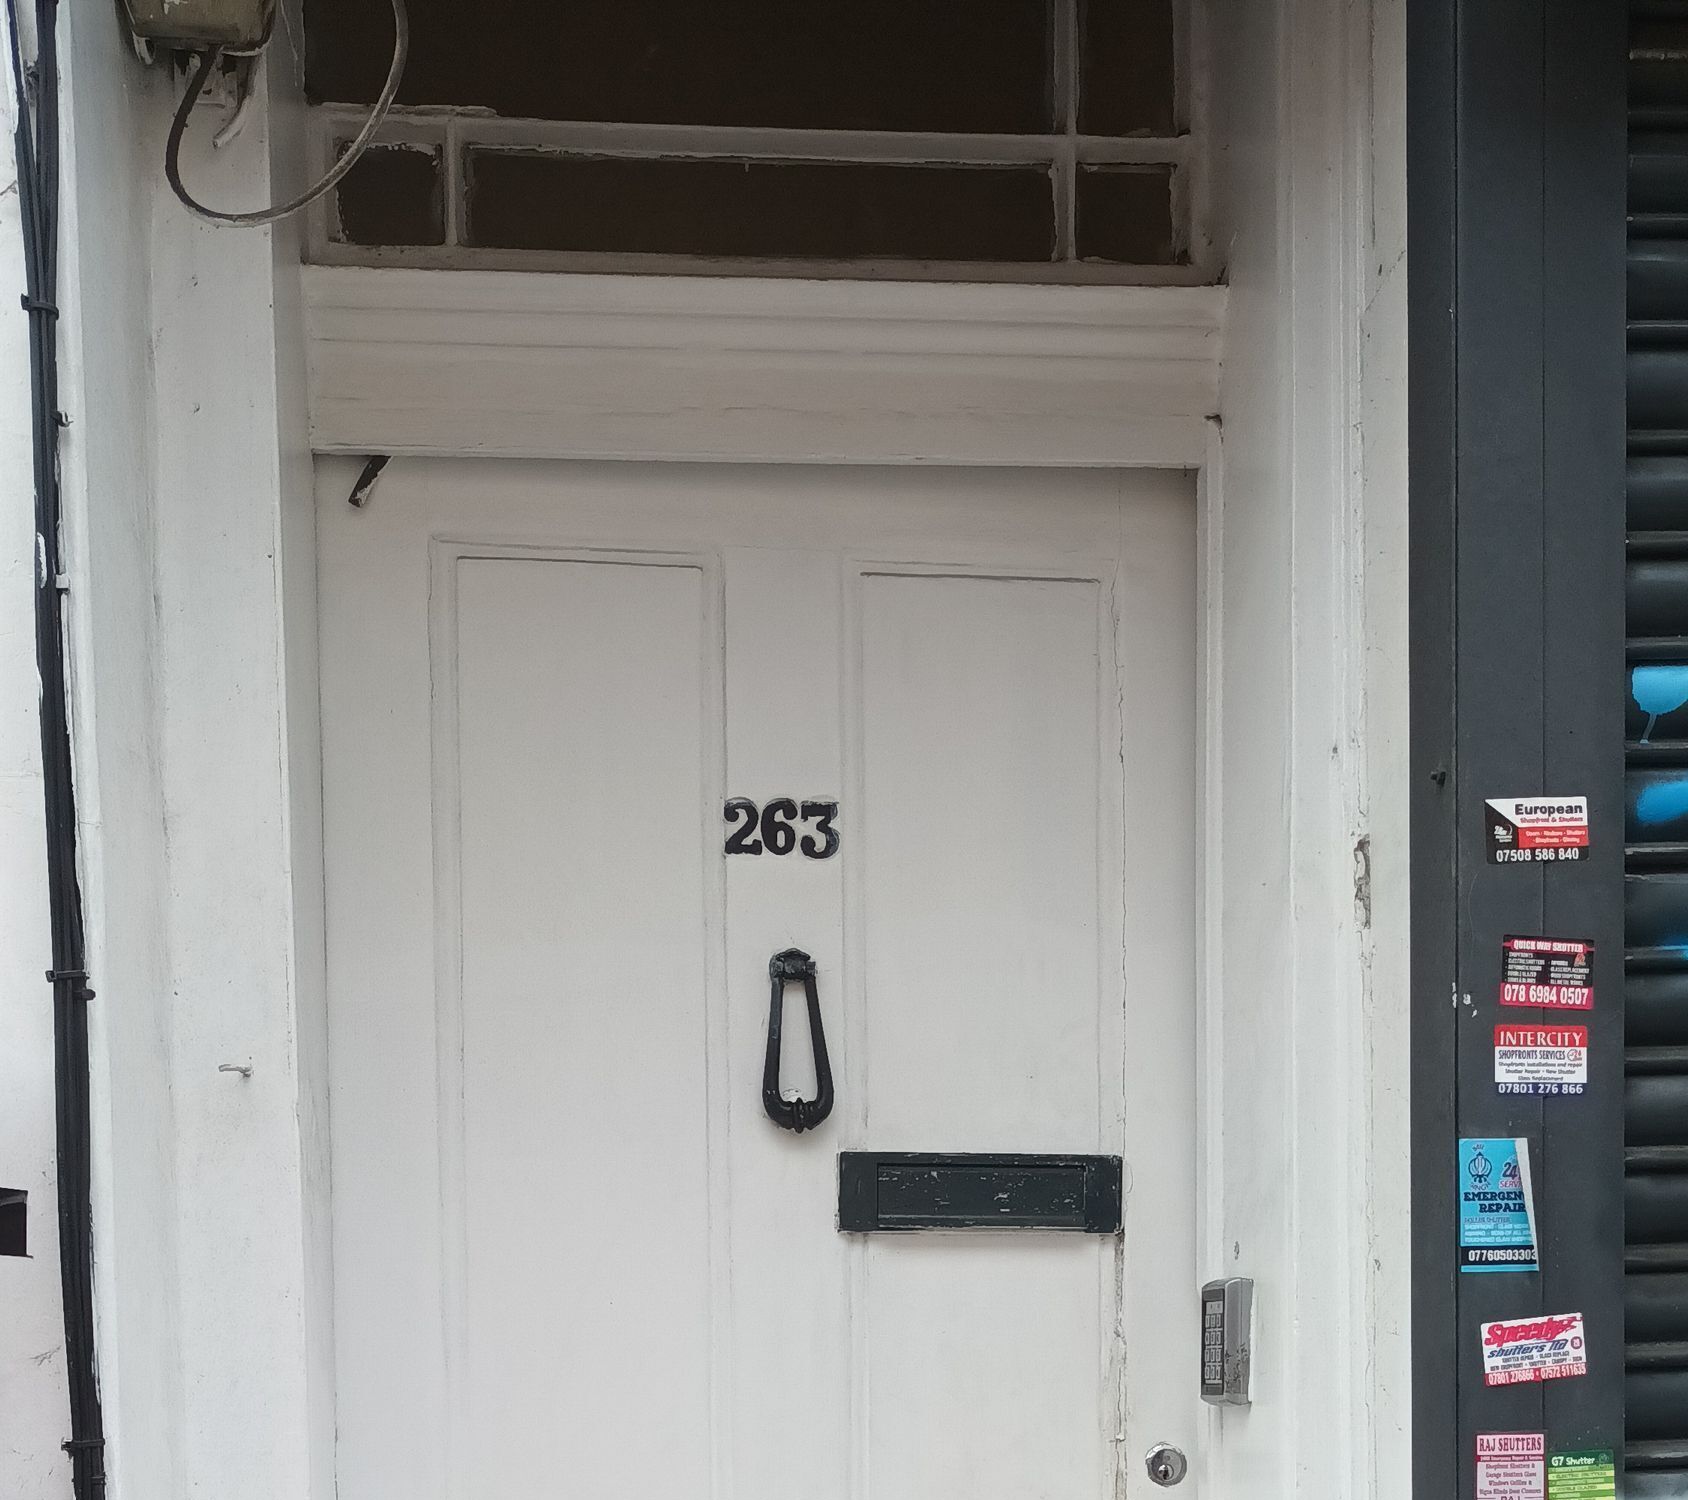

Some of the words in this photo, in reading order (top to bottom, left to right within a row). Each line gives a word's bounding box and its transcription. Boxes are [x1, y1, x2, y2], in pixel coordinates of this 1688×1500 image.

[1515, 804, 1583, 816] European
[724, 797, 839, 859] 263
[1496, 849, 1531, 862] 07508
[1535, 848, 1555, 860] 586
[1558, 848, 1579, 860] 840
[1504, 984, 1526, 1001] 078
[1529, 985, 1557, 1003] 6984
[1560, 987, 1589, 1005] 0507
[1500, 1031, 1582, 1046] INTERCITY
[1499, 1049, 1537, 1060] SHOPFRONTS
[1539, 1050, 1566, 1060] SERVICES
[1498, 1083, 1534, 1094] 07801
[1538, 1084, 1558, 1094] 276
[1561, 1084, 1583, 1094] 866
[1479, 1438, 1496, 1452] RAJ
[1498, 1437, 1542, 1451] SHUTTERS
[1551, 1456, 1564, 1466] G7
[1566, 1456, 1595, 1465] Shutter
